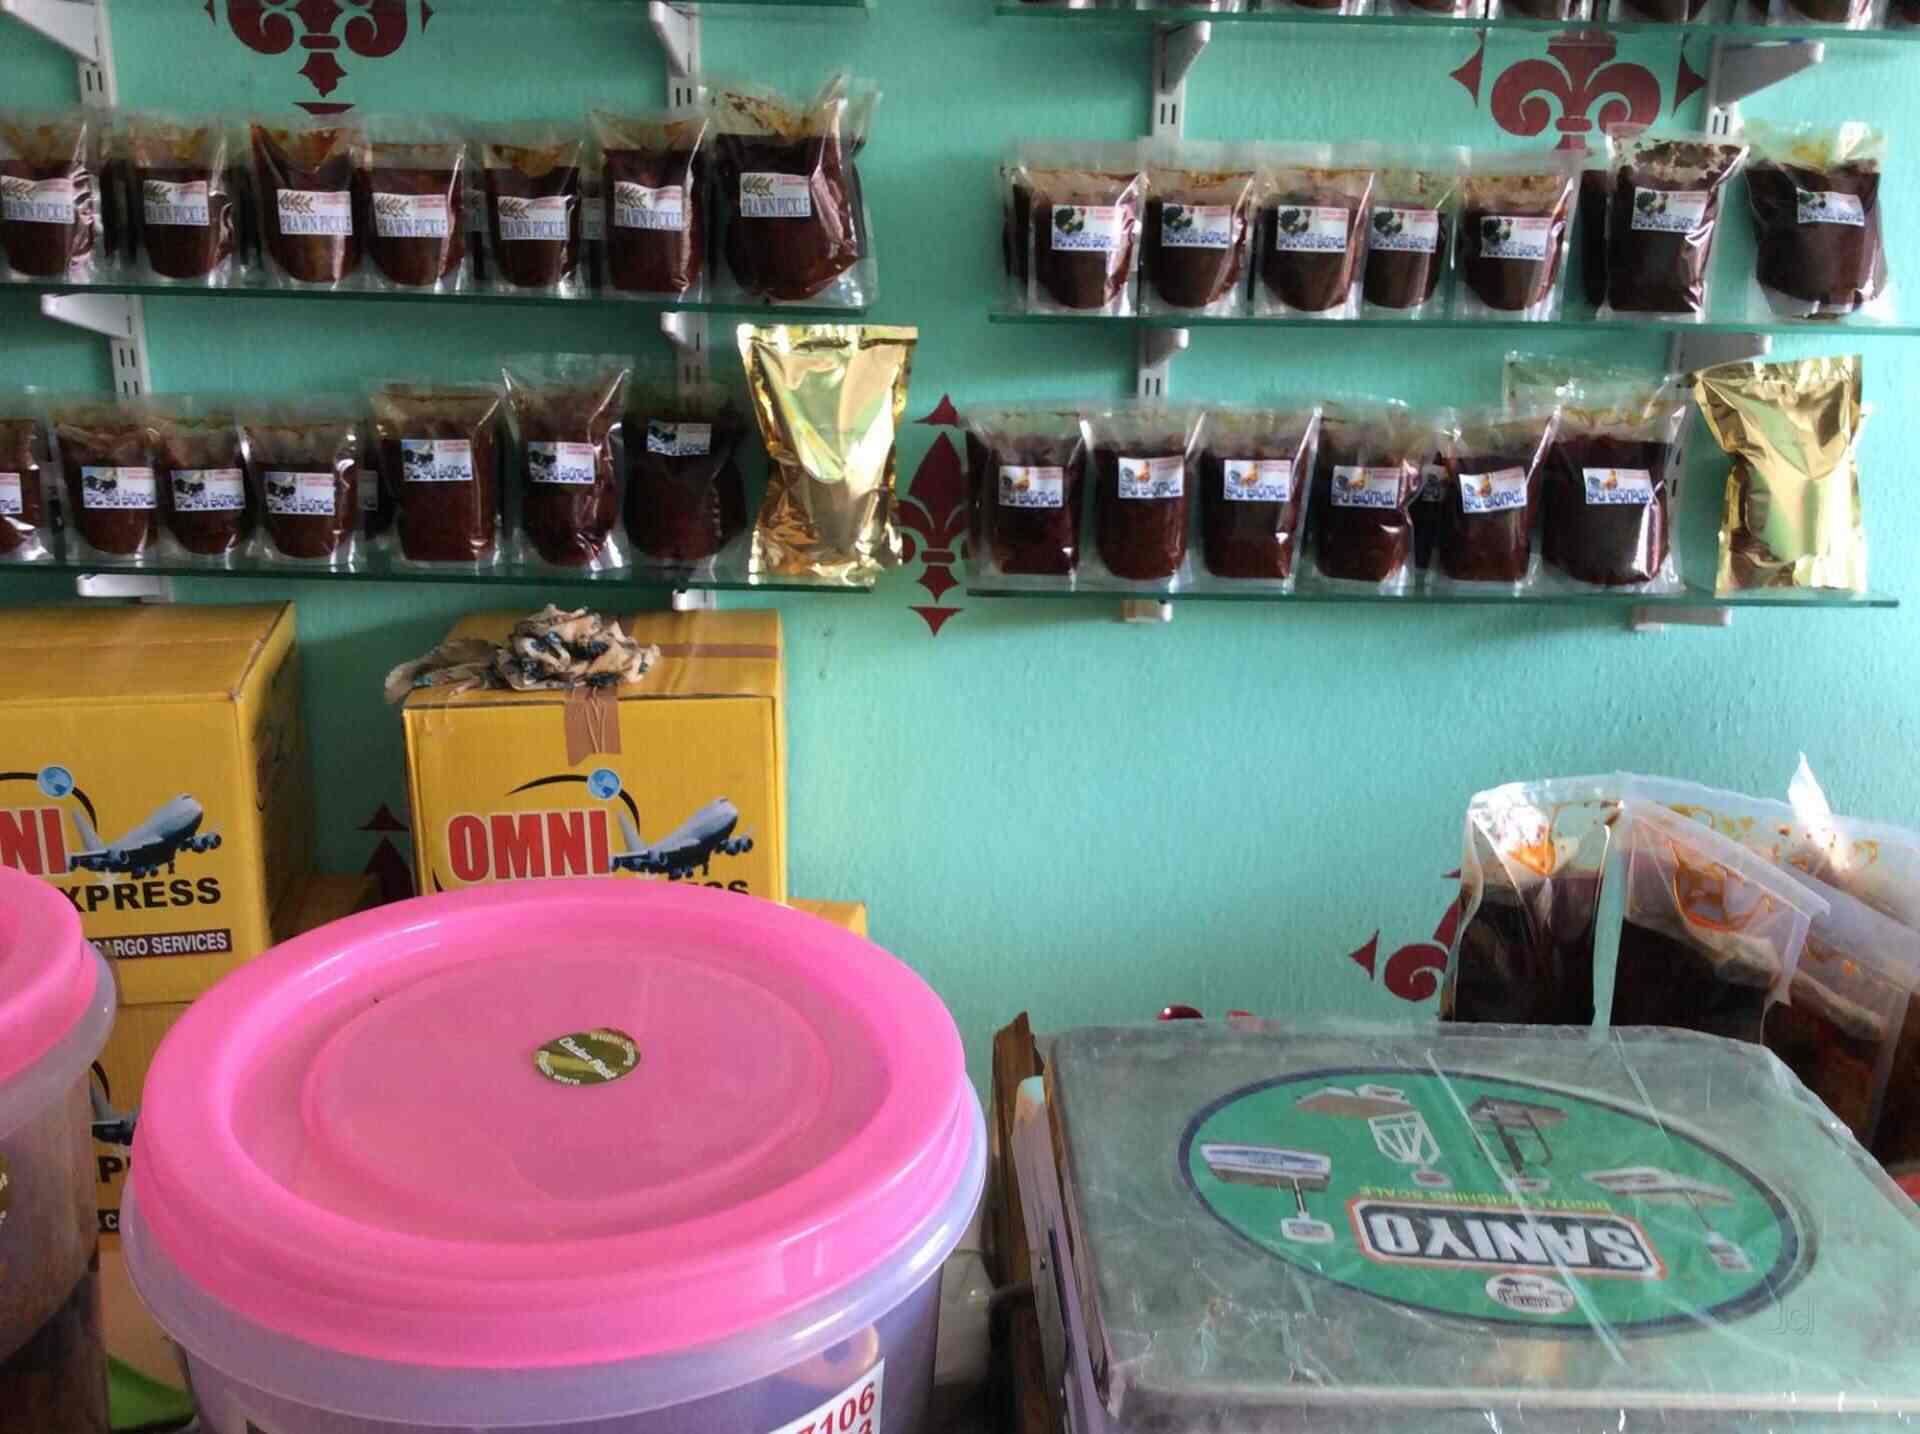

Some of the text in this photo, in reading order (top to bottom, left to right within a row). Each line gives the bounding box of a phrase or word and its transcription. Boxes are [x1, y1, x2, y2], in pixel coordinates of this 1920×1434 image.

[777, 198, 809, 216] PICKLE
[281, 215, 351, 234] PRAWN PICKLE
[414, 219, 446, 236] PICKLE
[447, 810, 609, 882] OMNI
[152, 932, 228, 953] SERVICES
[1368, 1213, 1648, 1270] SANIYO
